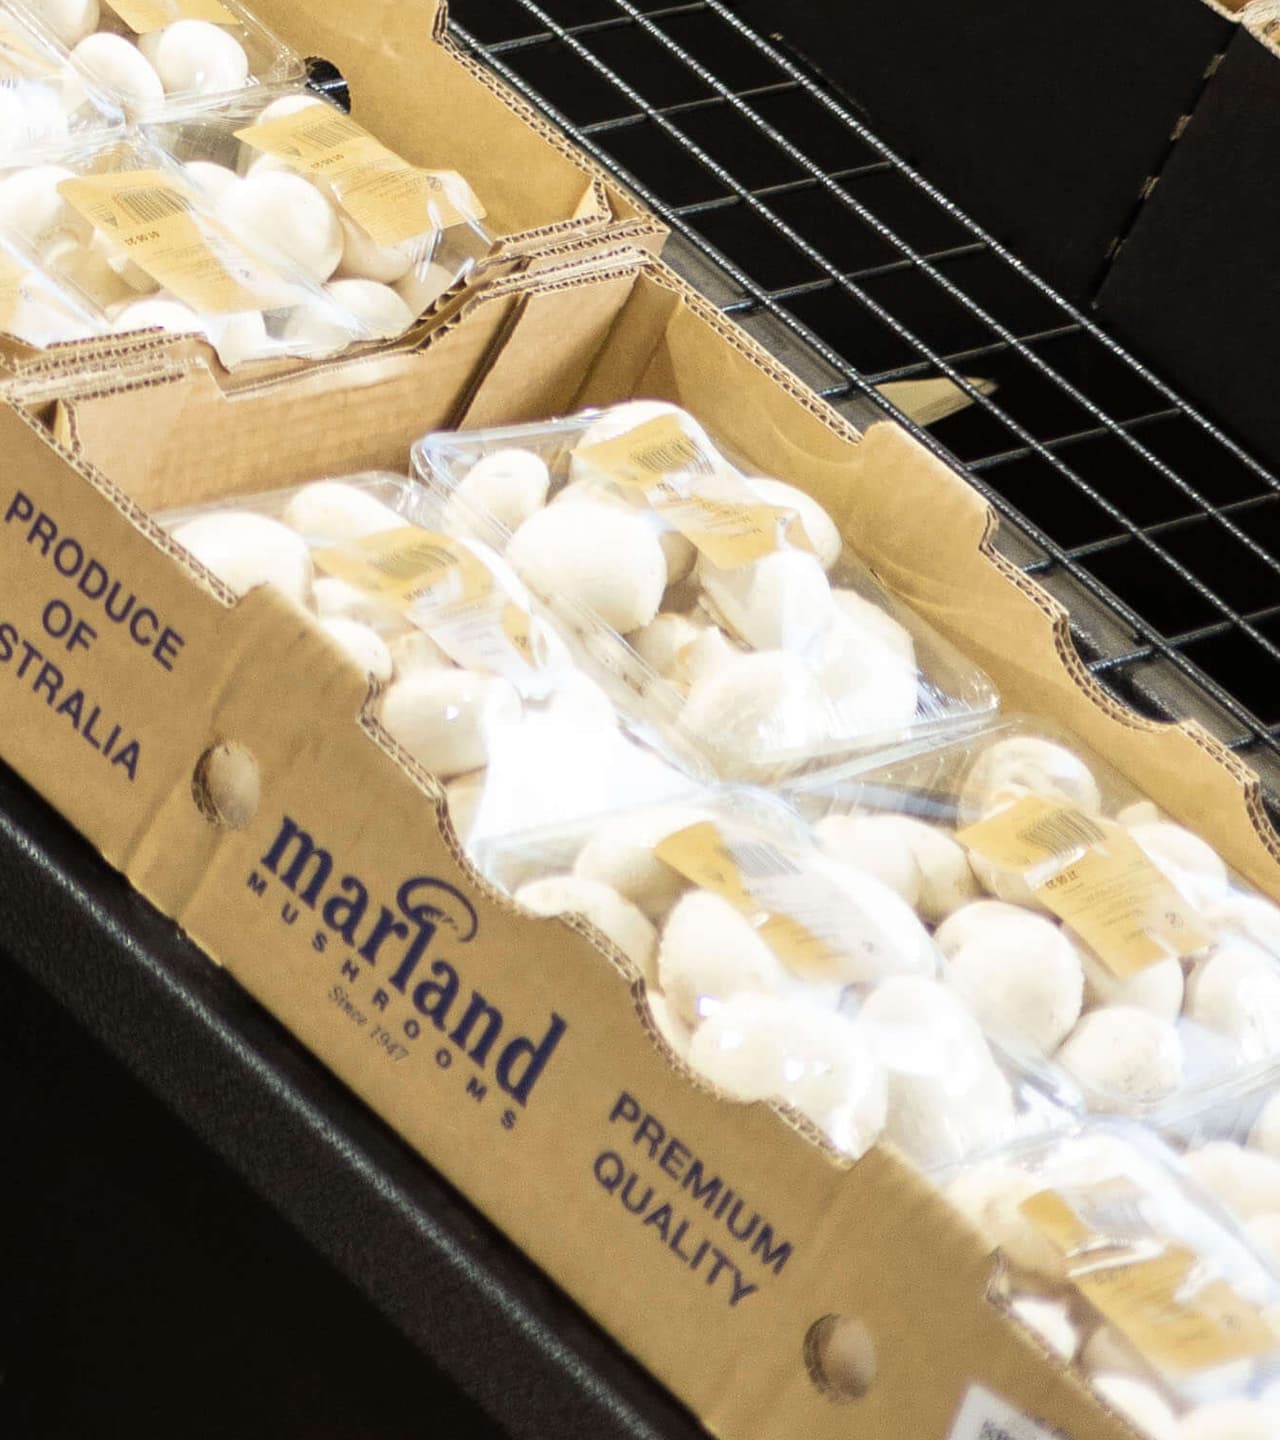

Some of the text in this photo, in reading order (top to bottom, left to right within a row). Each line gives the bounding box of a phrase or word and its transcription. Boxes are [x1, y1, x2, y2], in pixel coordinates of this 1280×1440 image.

[4, 491, 186, 672] PRODUCE
[40, 600, 99, 656] OF
[246, 870, 518, 1132] MUSHROOMS
[260, 816, 568, 1109] marland
[592, 1150, 759, 1308] QUALITY
[608, 1091, 795, 1277] PREMIUM
